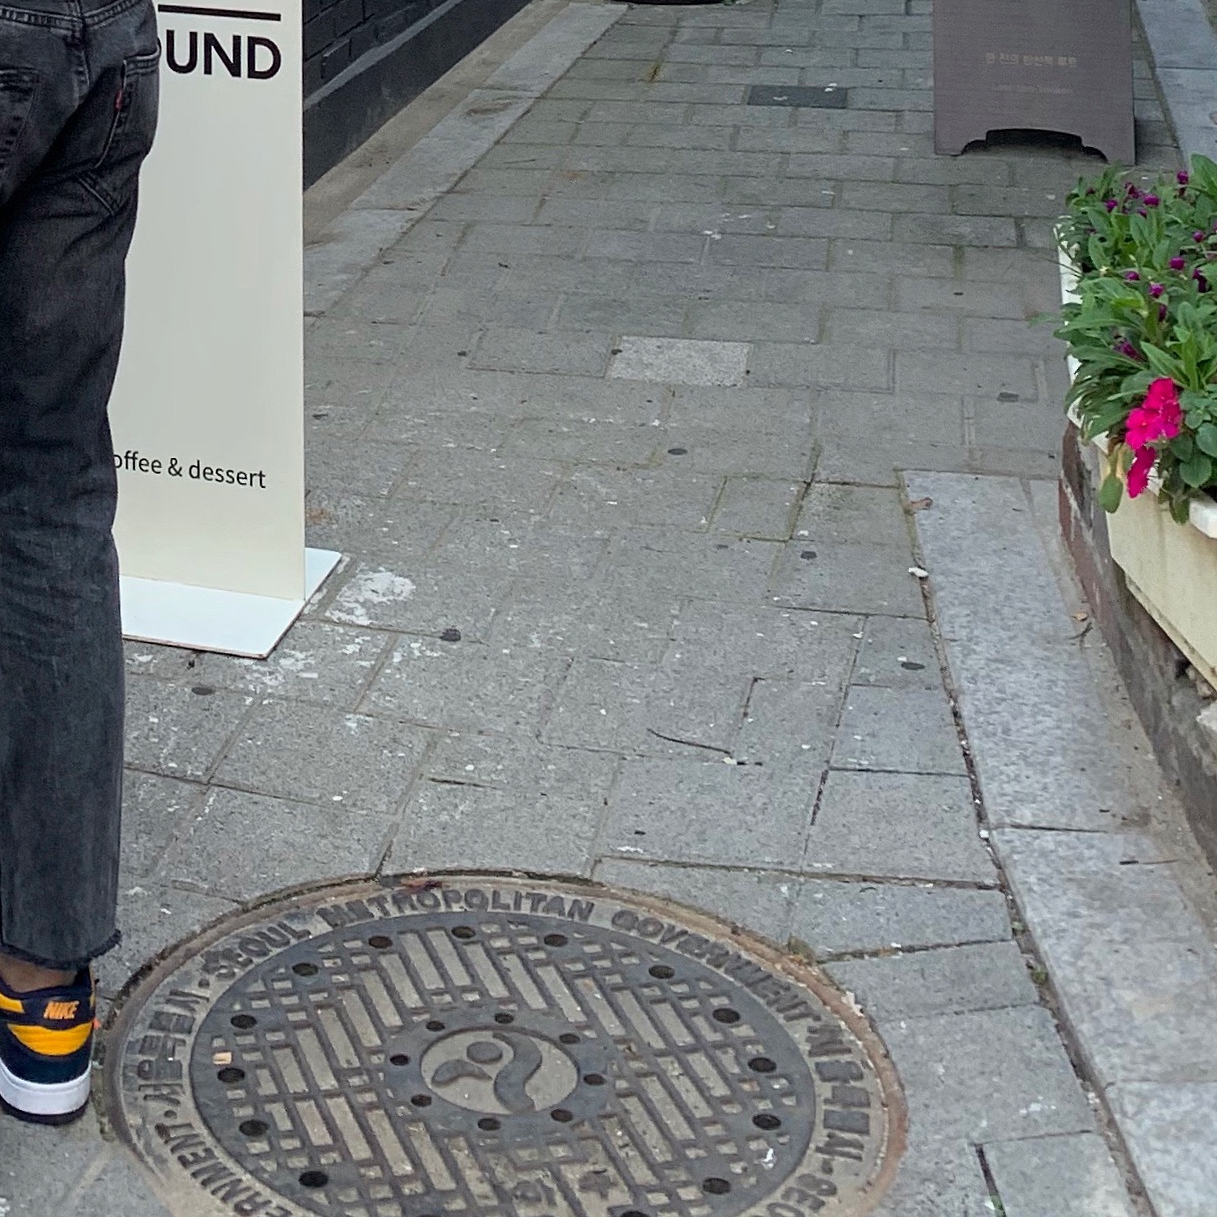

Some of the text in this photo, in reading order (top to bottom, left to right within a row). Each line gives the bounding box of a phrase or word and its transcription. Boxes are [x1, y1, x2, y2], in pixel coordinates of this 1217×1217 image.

[158, 29, 282, 80] UND
[168, 457, 183, 478] &
[188, 460, 267, 489] dessert
[200, 888, 822, 1023] SEOUL METROPOLITAN GOVERNMENT
[43, 1000, 81, 1020] NIKE
